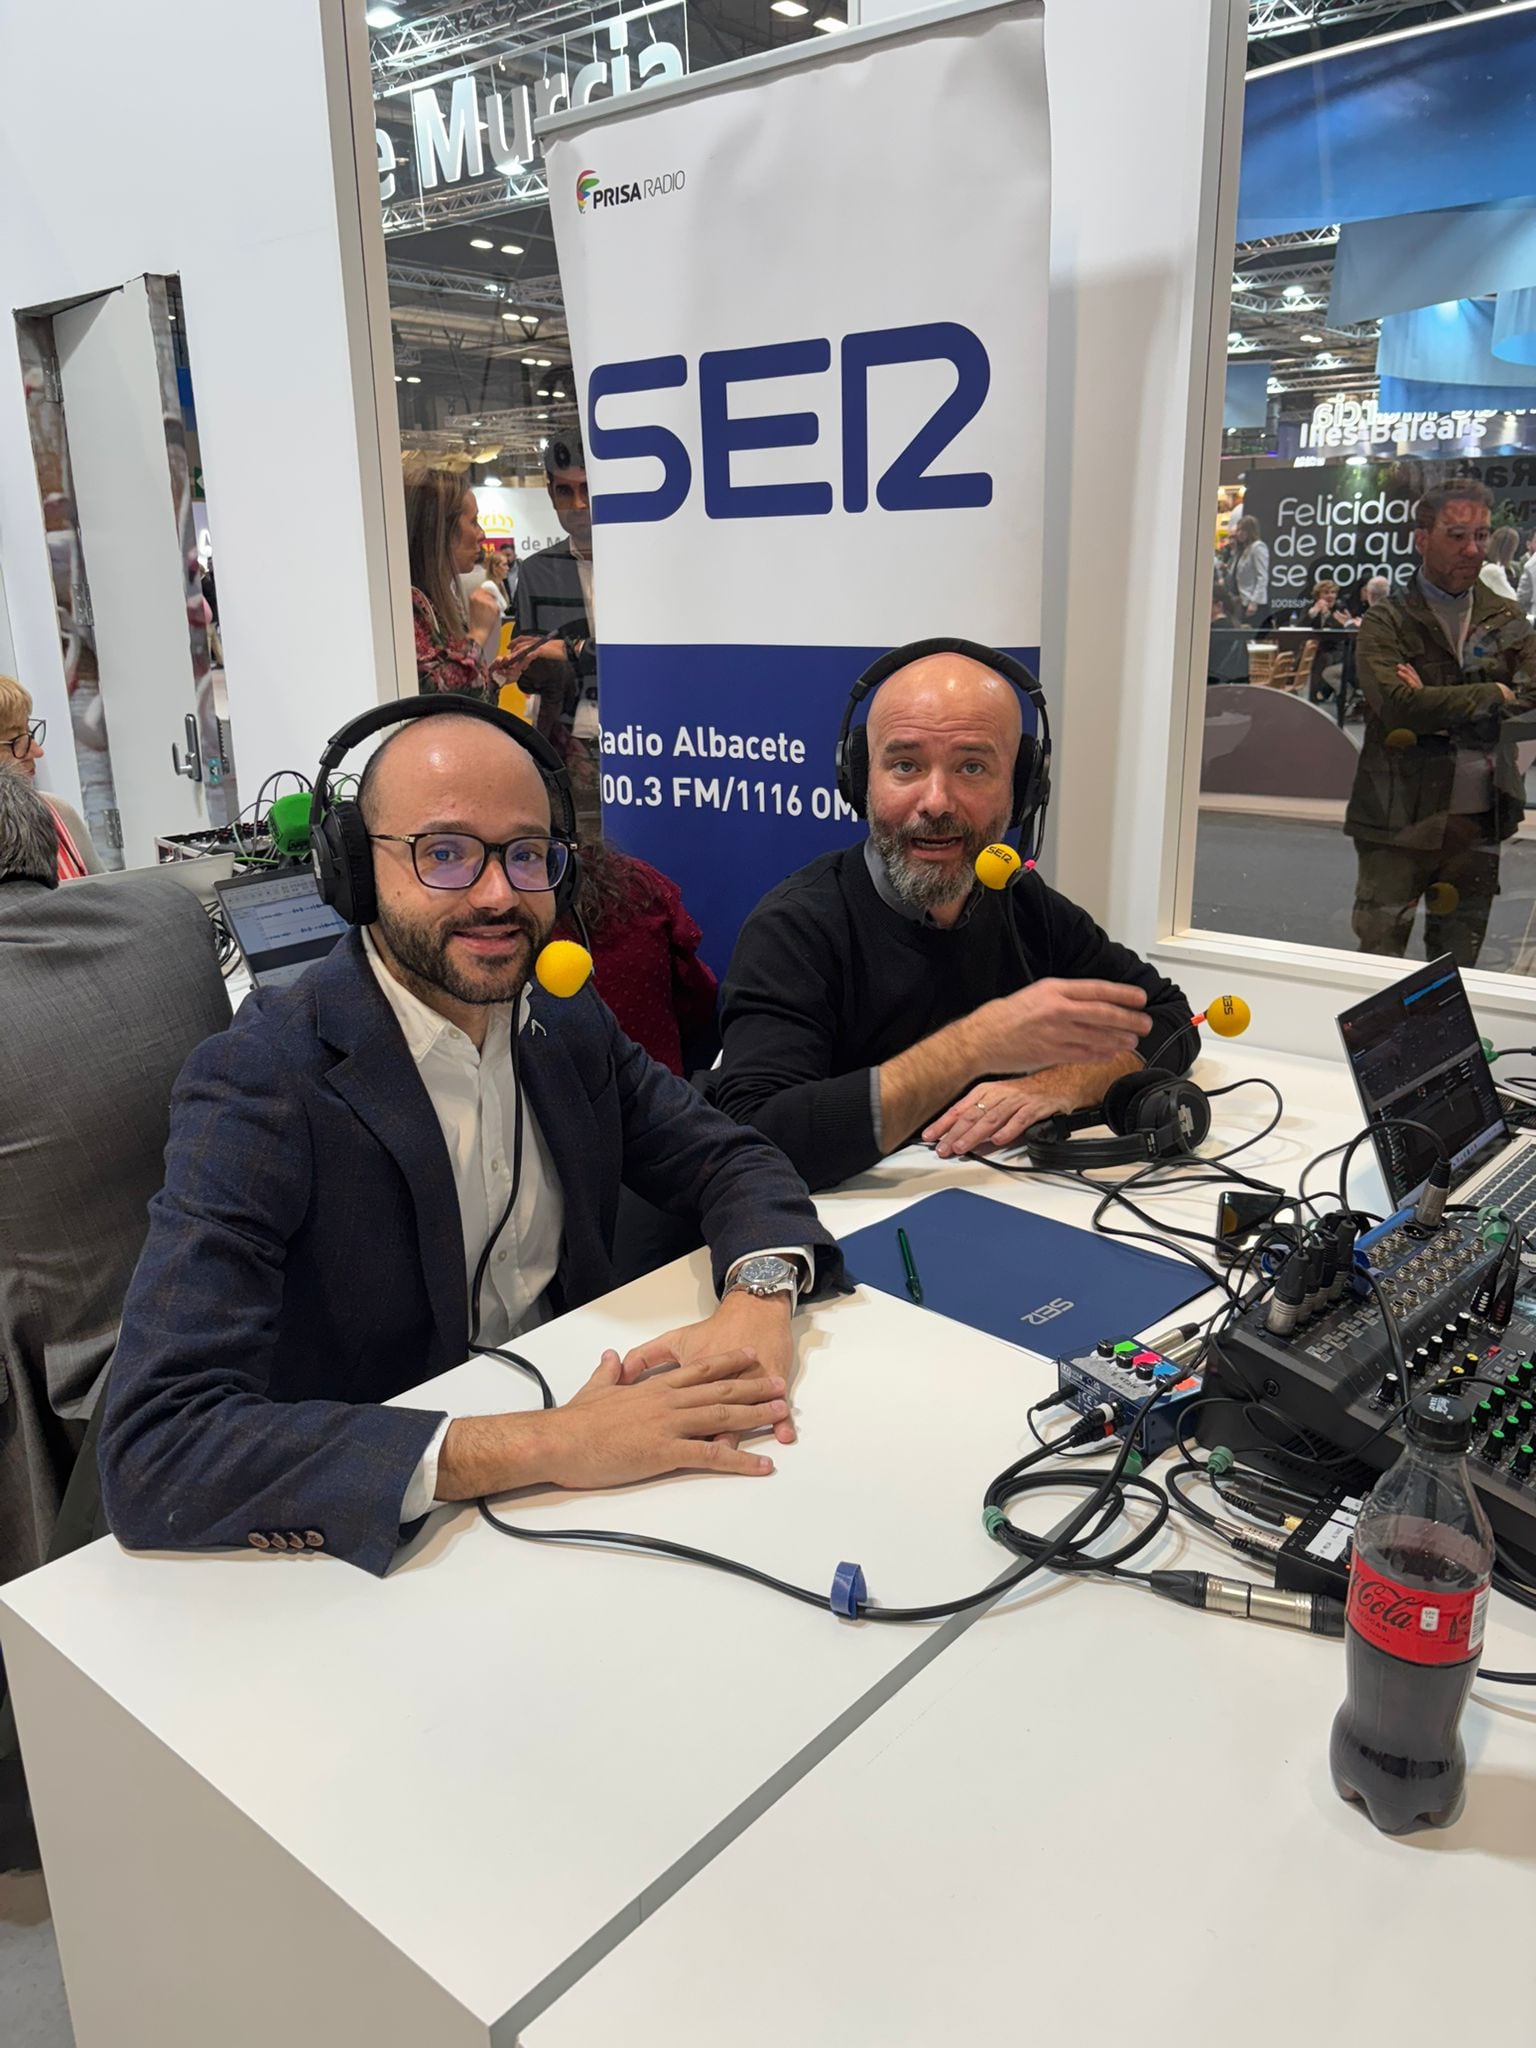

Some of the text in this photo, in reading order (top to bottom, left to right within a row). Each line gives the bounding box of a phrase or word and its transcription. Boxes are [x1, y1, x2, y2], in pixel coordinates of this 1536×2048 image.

[375, 20, 685, 201] e Murcia
[592, 170, 686, 210] PRISA RADIO
[588, 321, 993, 526] SER
[1370, 415, 1488, 444] Balears
[1277, 492, 1421, 527] Felicida
[522, 536, 561, 551] de M
[1273, 526, 1415, 562] de la qu
[1271, 563, 1417, 587] se come
[599, 724, 806, 764] adio Albacete
[600, 773, 663, 807] 00.3
[673, 776, 803, 817] FM/1116
[986, 846, 1013, 864] SER
[1020, 1297, 1075, 1325] SER
[1358, 1580, 1423, 1630] Cola
